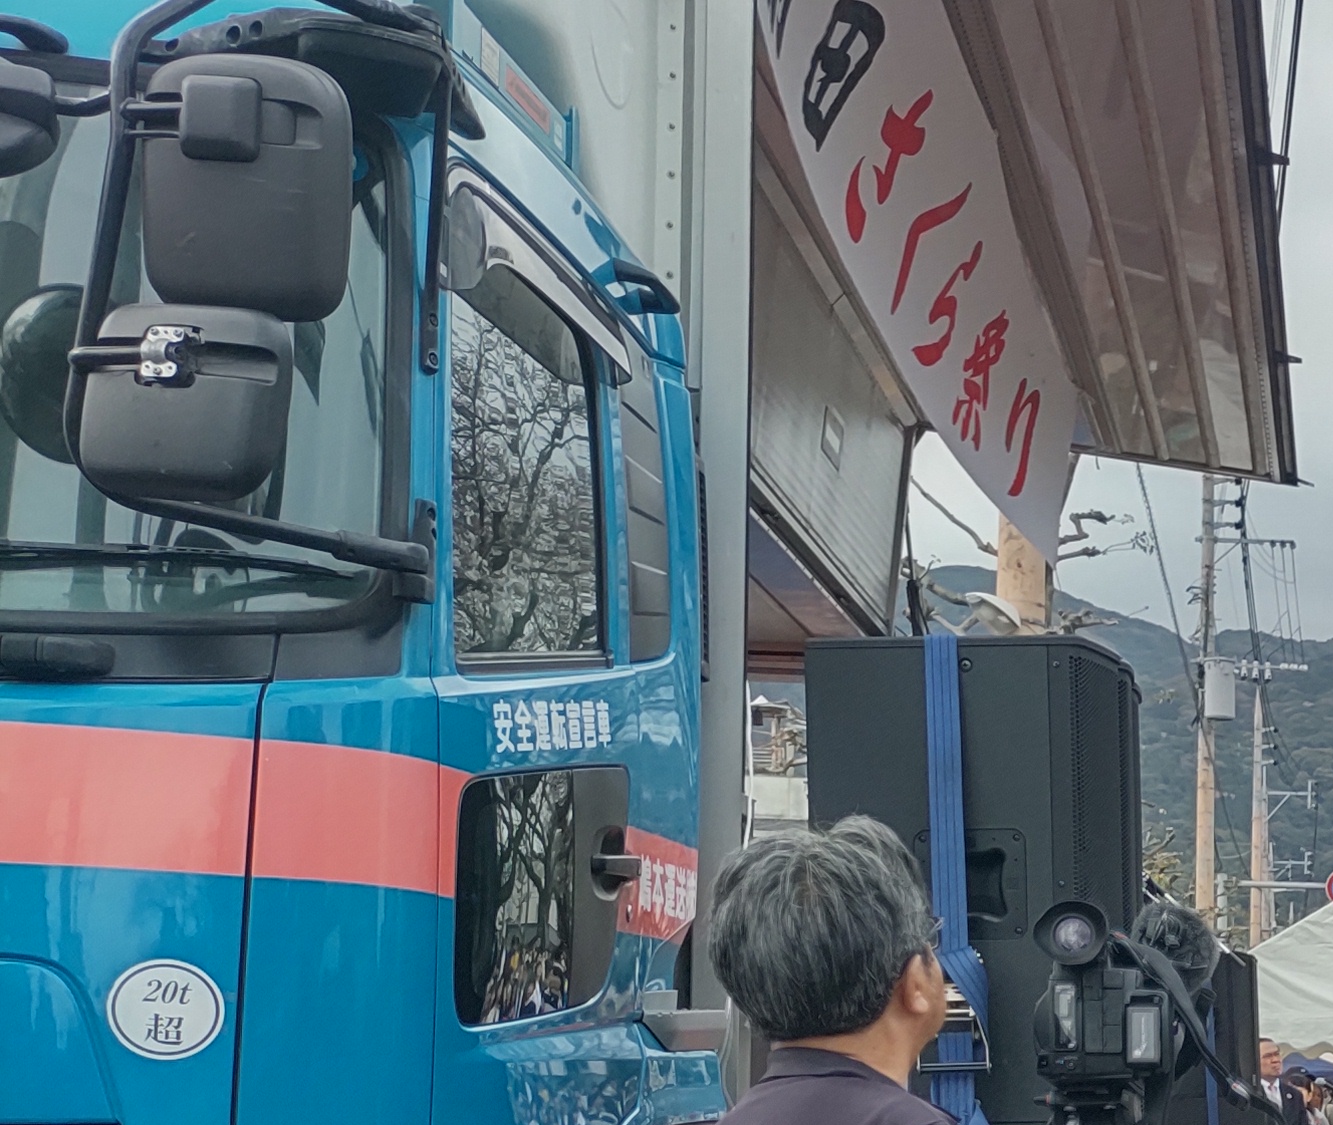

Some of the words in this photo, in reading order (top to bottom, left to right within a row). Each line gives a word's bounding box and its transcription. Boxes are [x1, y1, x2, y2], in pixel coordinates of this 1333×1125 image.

[758, 0, 1041, 498] 田さくら祭り
[493, 699, 612, 754] 安全運転宣言車
[141, 977, 192, 1006] 20t
[145, 1013, 183, 1046] 超
